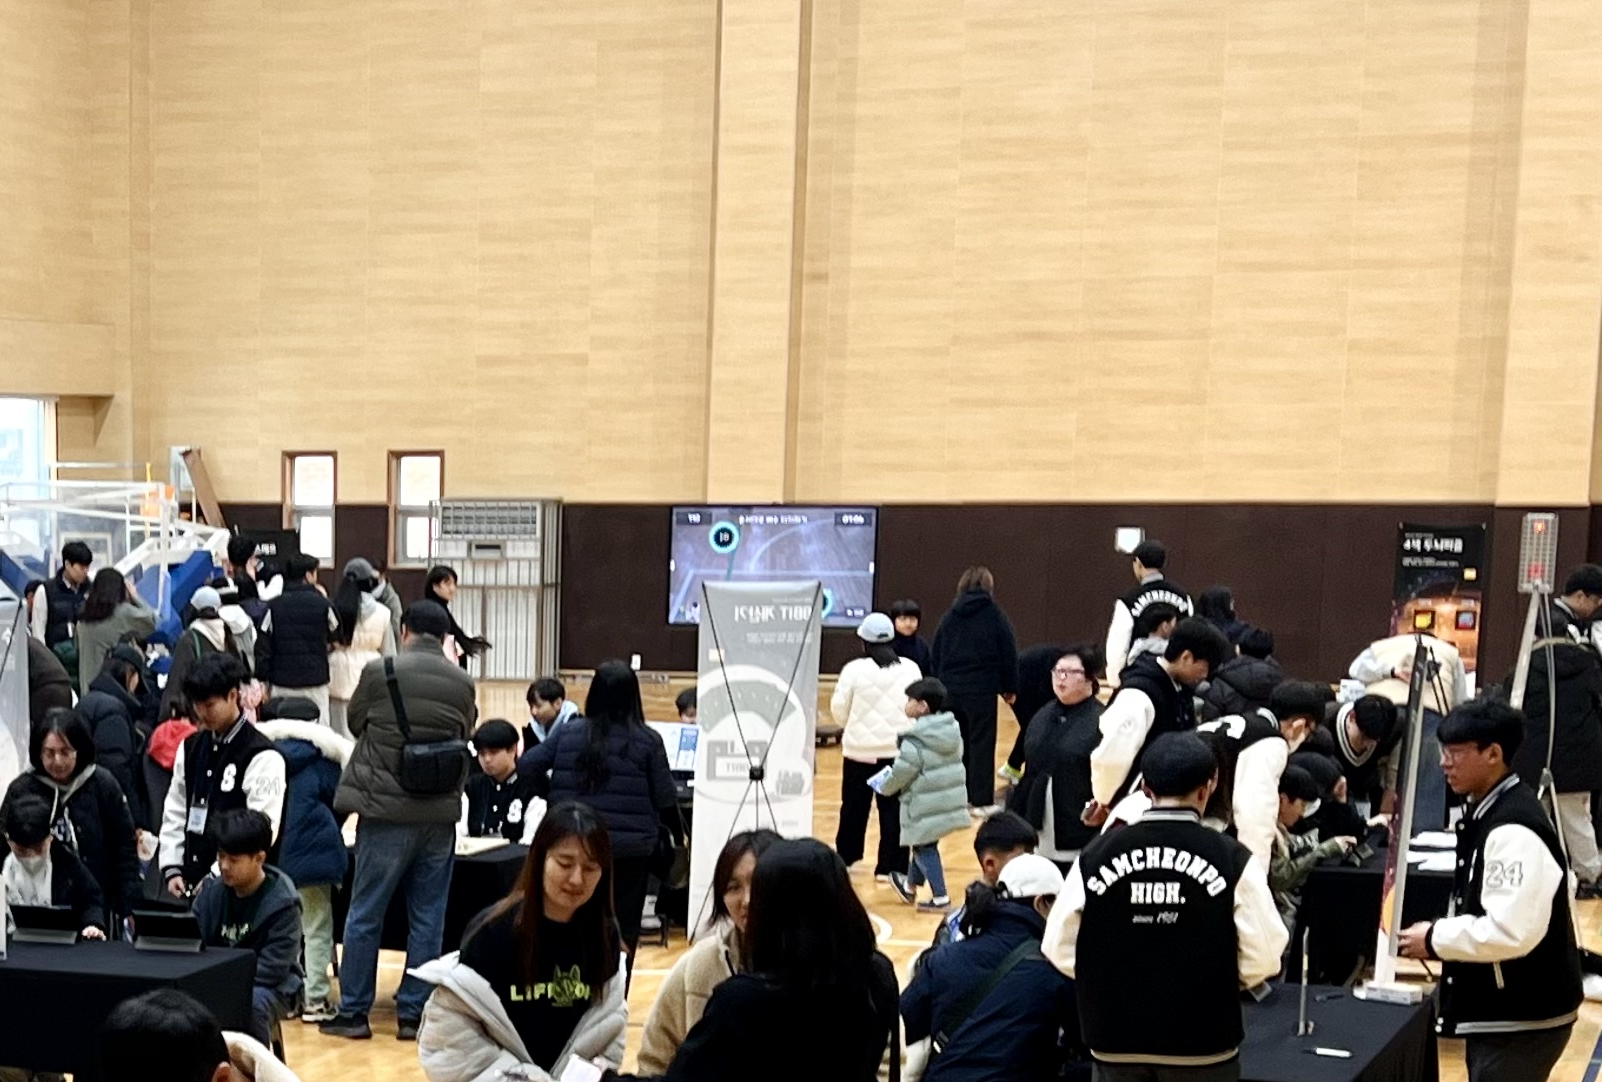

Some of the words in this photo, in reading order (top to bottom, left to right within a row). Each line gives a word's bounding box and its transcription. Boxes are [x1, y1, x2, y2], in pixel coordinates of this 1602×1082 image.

[1087, 846, 1227, 896] SAMCHEONPO
[1485, 859, 1524, 888] 24
[1130, 881, 1186, 904] HIGH.
